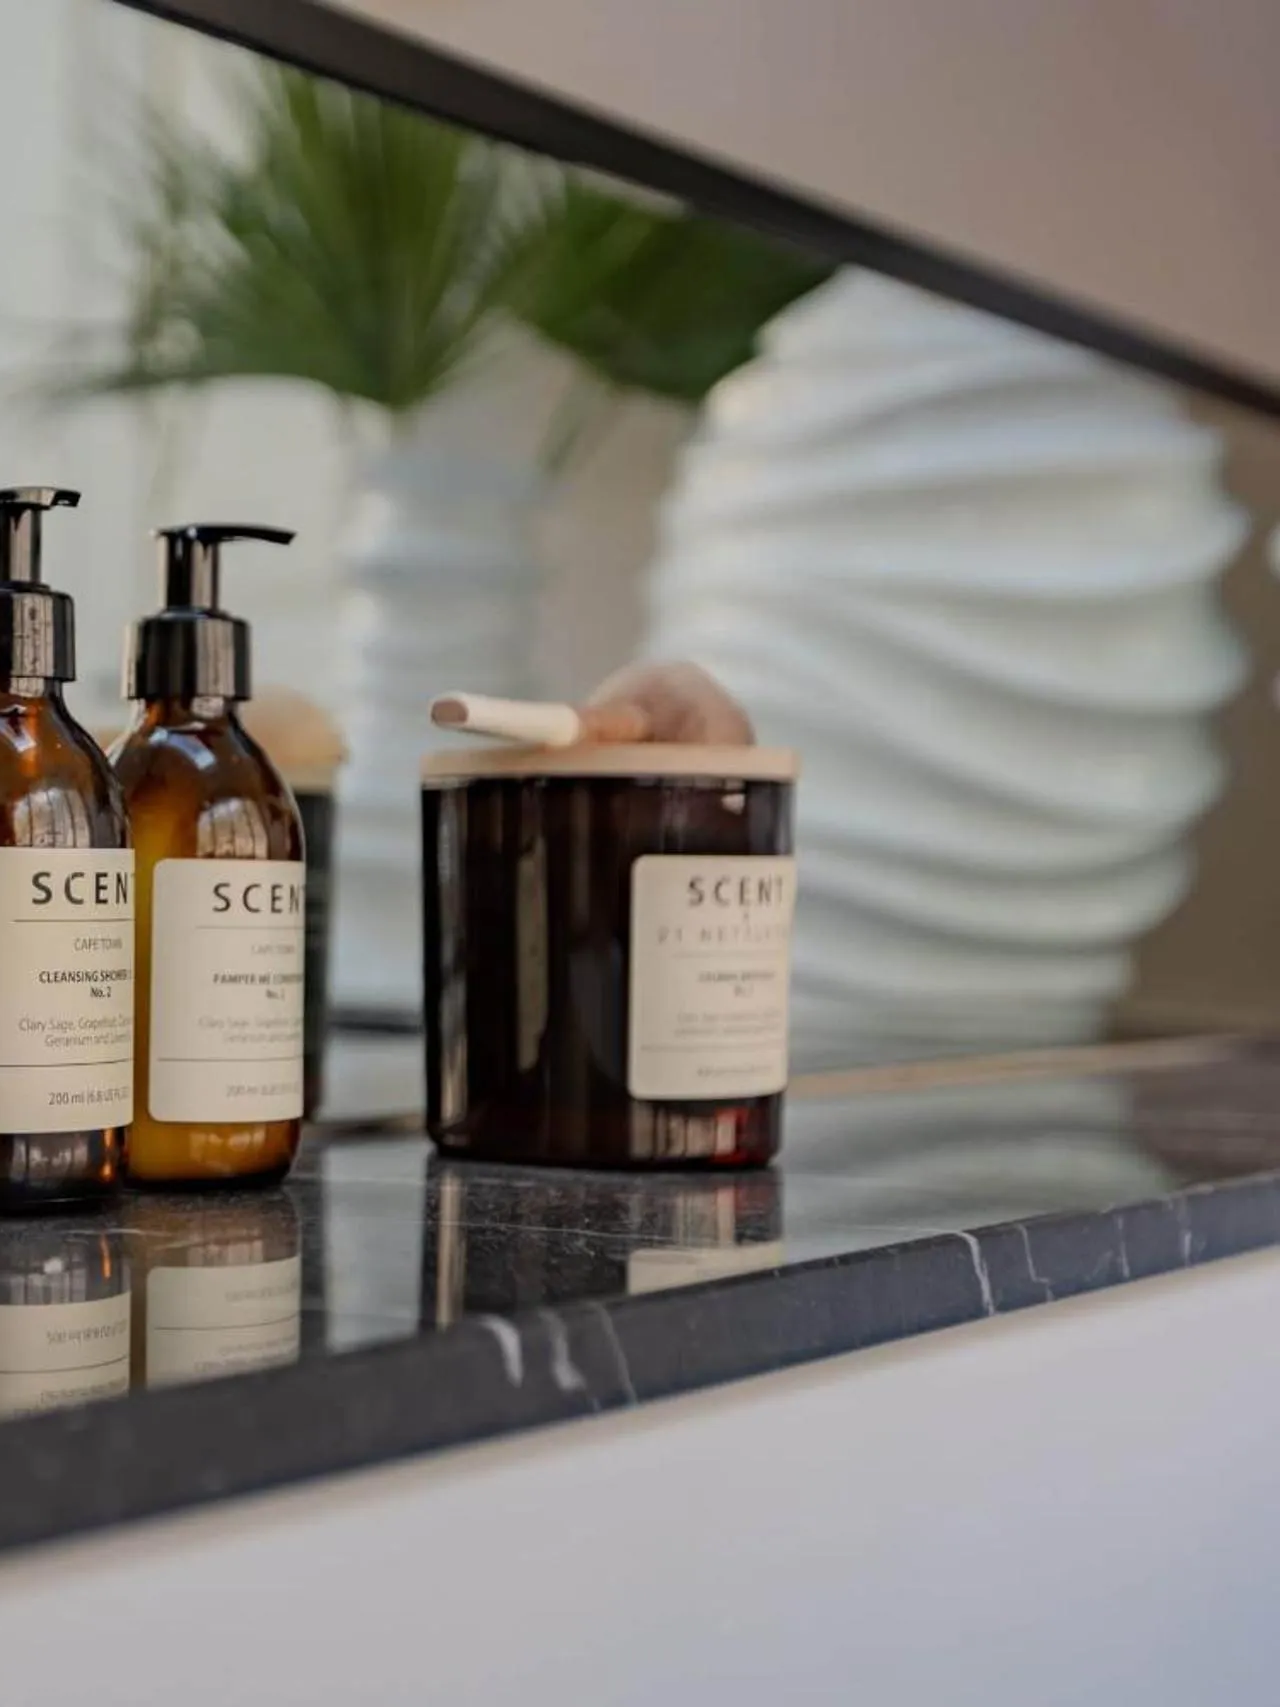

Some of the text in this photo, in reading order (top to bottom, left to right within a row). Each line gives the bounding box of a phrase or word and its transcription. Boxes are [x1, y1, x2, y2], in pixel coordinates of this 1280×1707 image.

[31, 871, 133, 905] SCEN
[212, 882, 305, 915] SCEN
[687, 875, 783, 907] SCENT
[38, 970, 98, 984] CLEANSING
[47, 1090, 70, 1106] 200
[71, 1089, 84, 1104] ml
